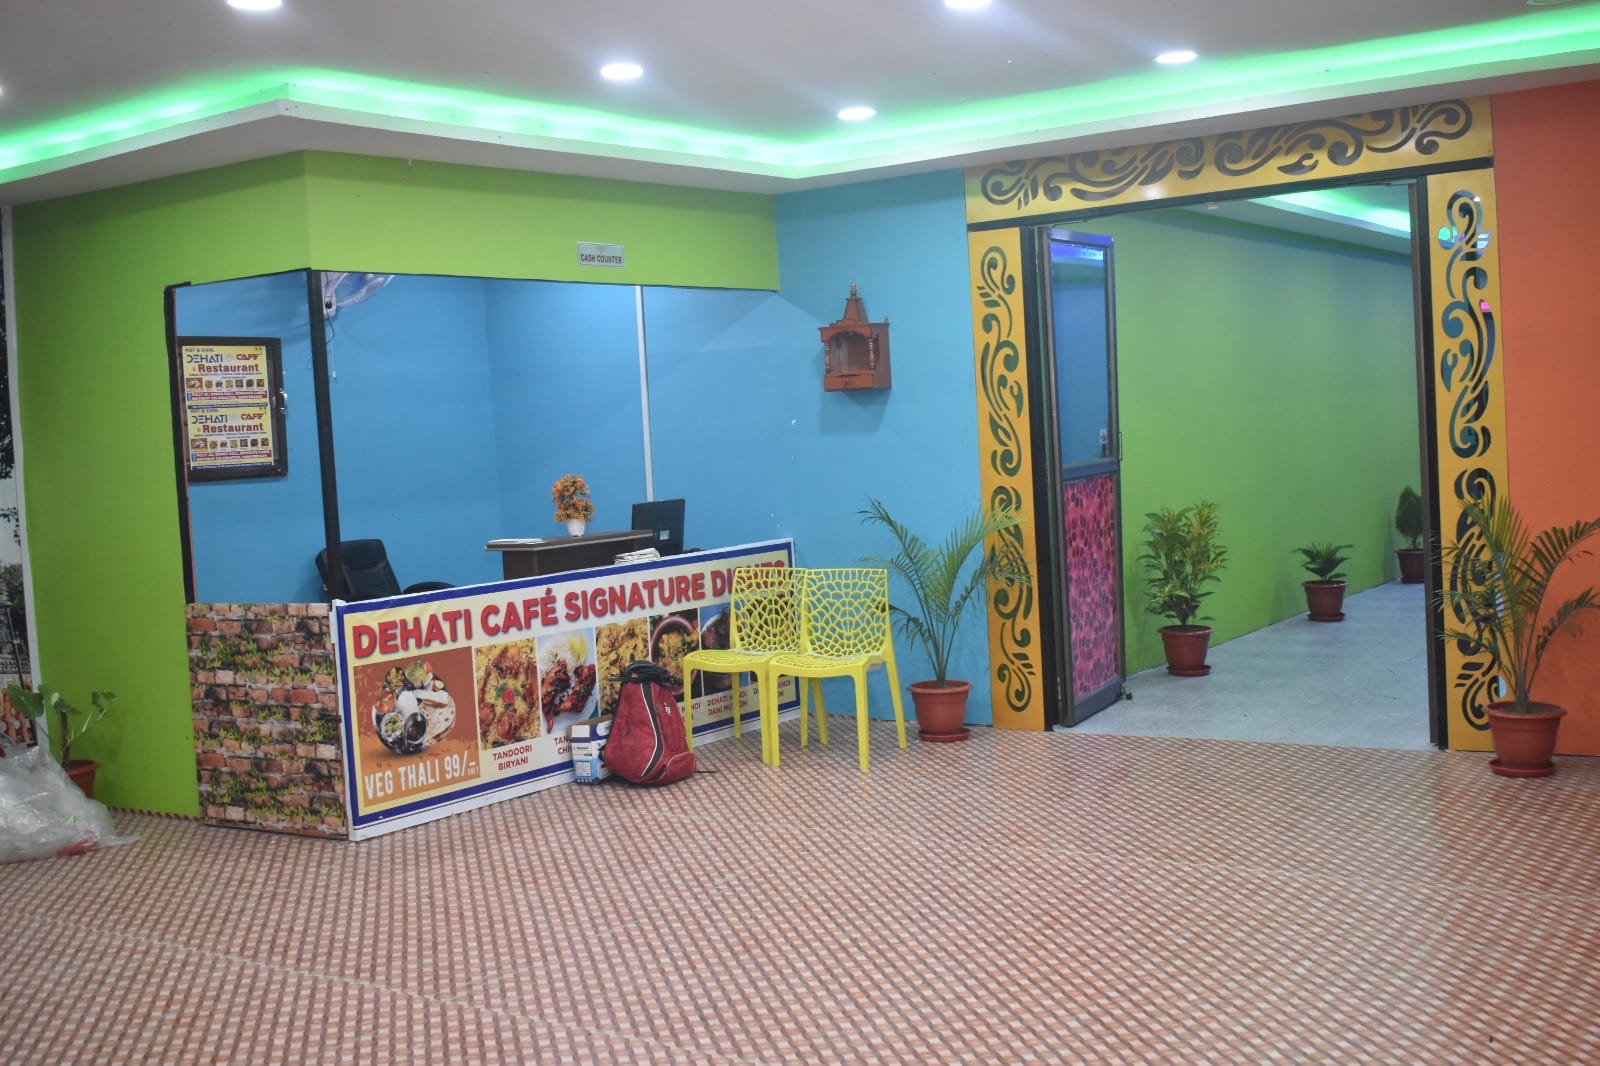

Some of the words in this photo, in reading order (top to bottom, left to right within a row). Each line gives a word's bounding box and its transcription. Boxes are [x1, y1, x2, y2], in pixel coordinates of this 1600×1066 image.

[580, 254, 596, 262] CASH
[596, 254, 623, 264] COUNTER
[187, 353, 223, 364] DEHATI
[198, 363, 259, 373] Restaurant
[191, 414, 228, 424] DEHATI
[202, 422, 264, 433] Restaurant
[352, 608, 472, 659] DEHATI
[480, 587, 558, 635] CAFÉ
[564, 573, 706, 621] SIGNATURE
[492, 744, 533, 761] TANDOORI
[498, 757, 529, 771] BIRYANI
[365, 770, 393, 799] VEG
[398, 758, 441, 791] THALI
